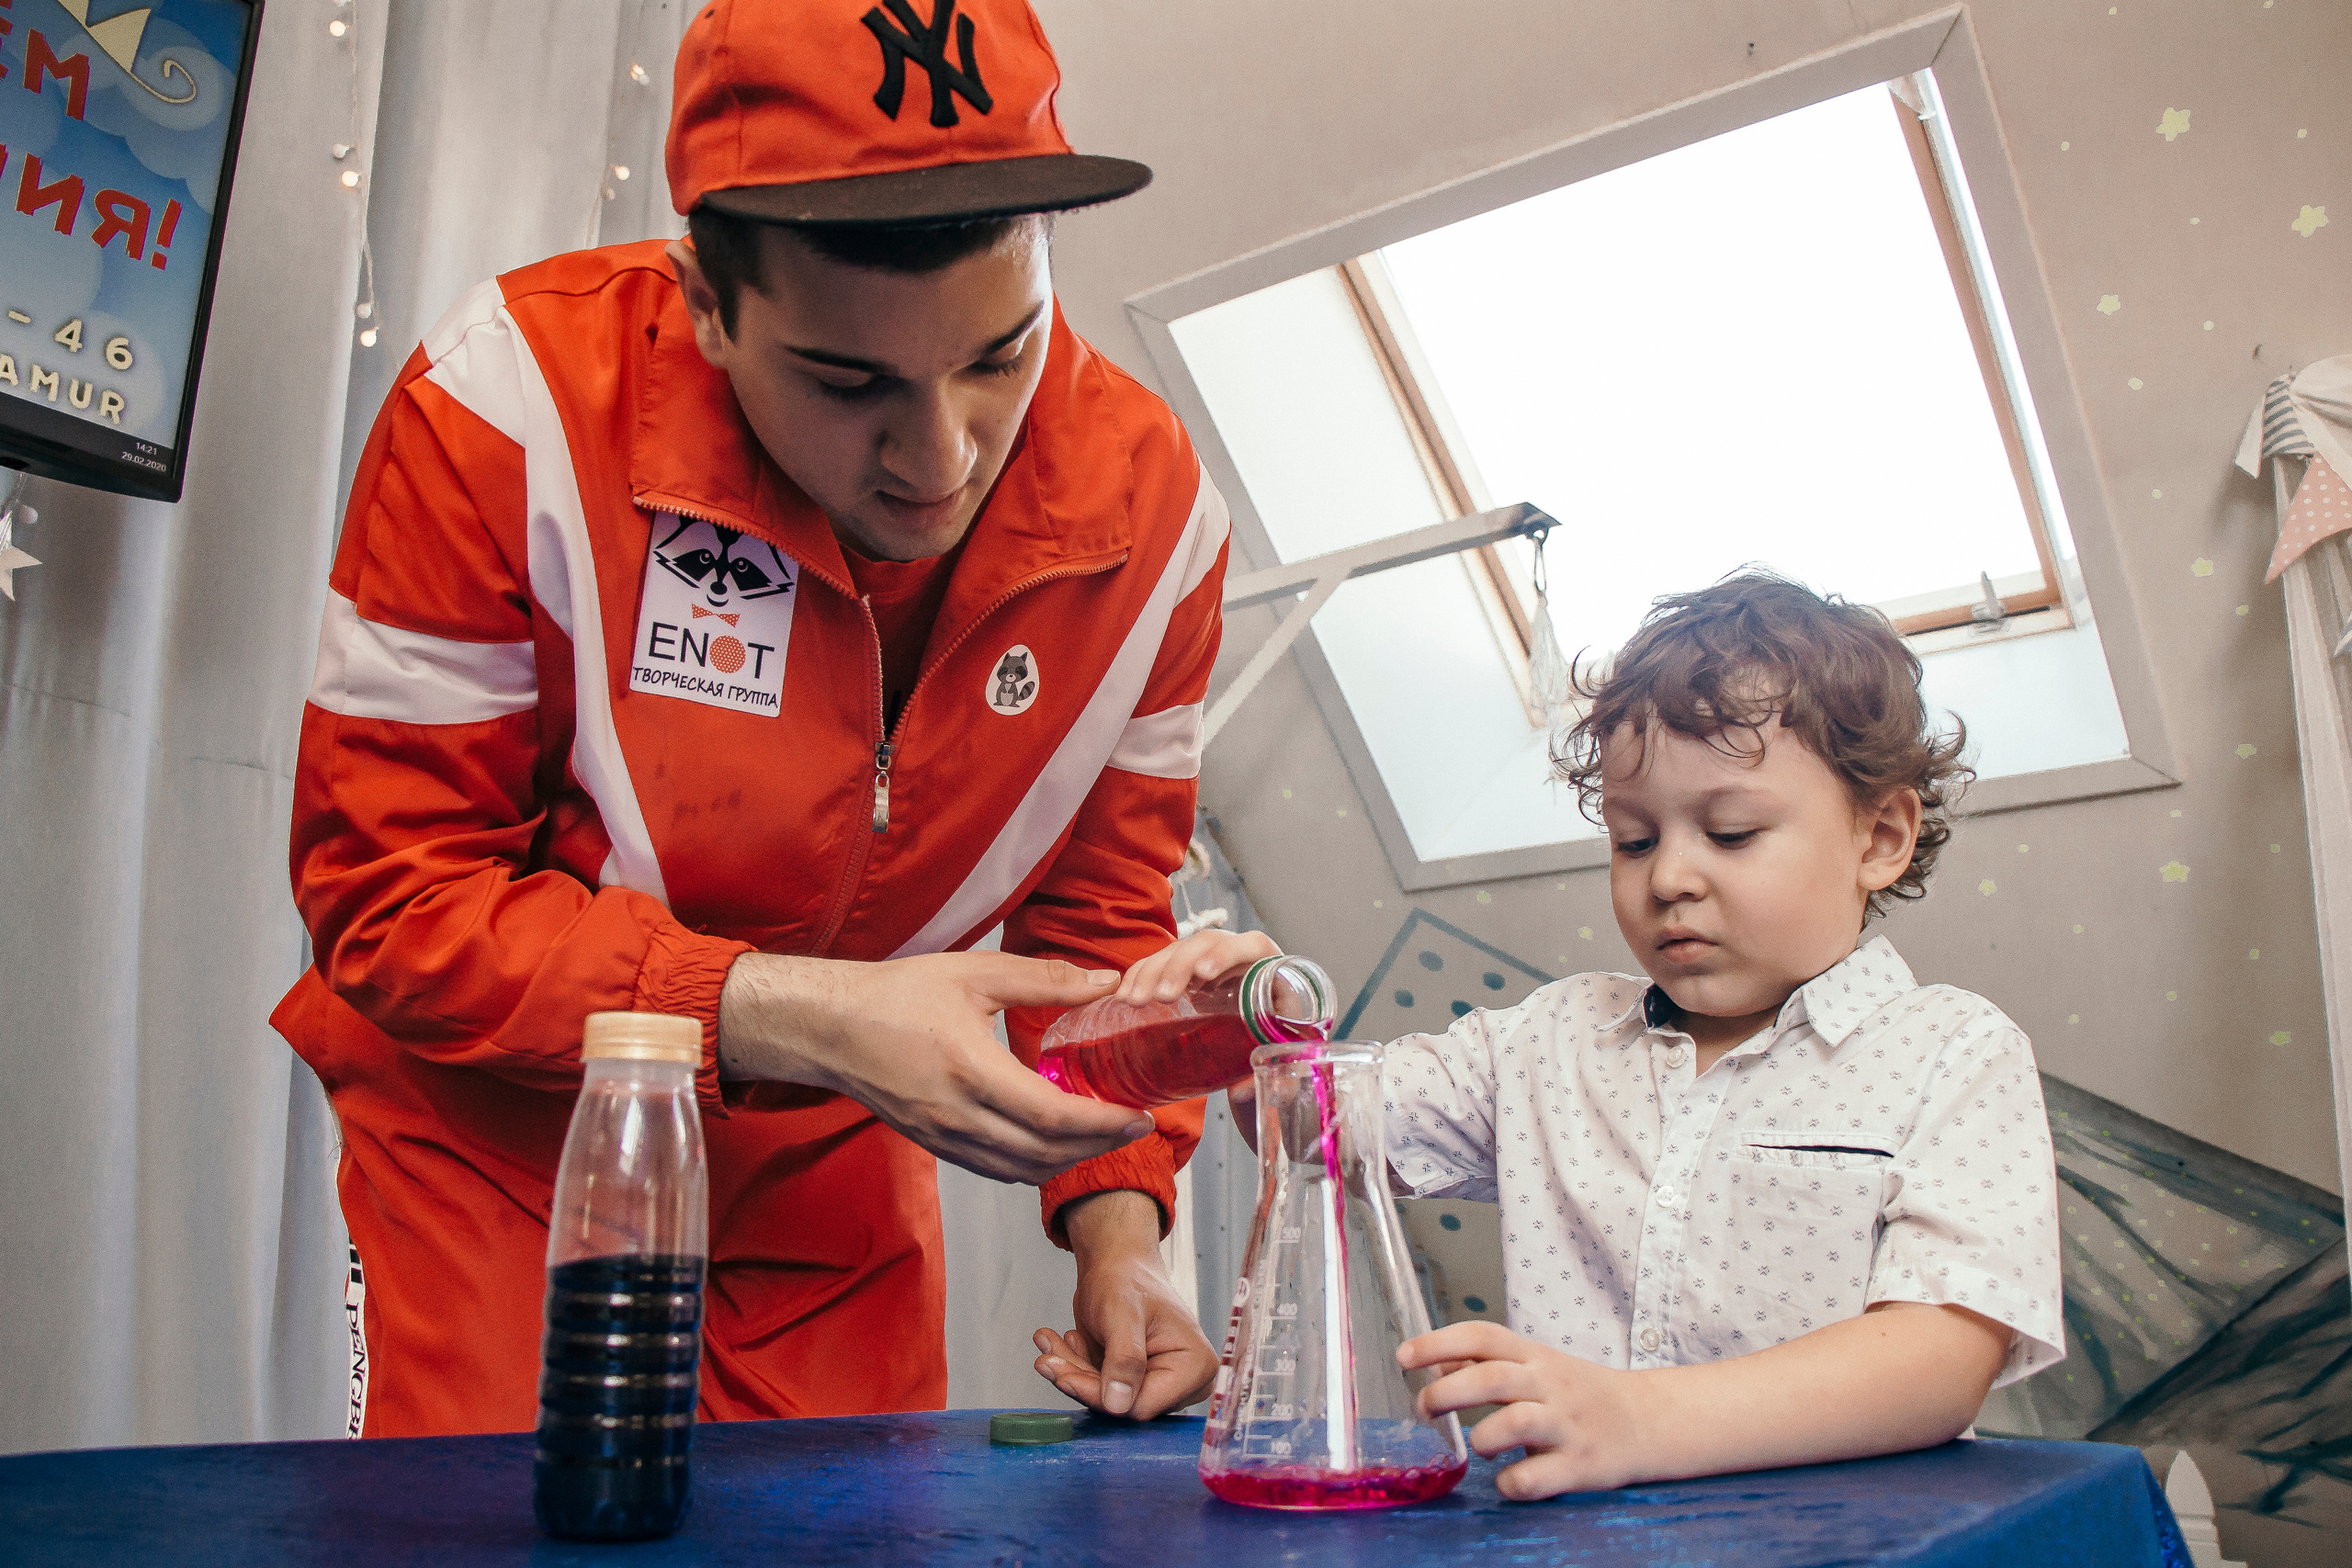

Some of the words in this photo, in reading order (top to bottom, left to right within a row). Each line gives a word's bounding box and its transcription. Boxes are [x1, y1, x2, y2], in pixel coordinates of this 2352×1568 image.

[860, 0, 994, 129] NY
[0, 143, 182, 270] ИЯ!
[121, 451, 166, 472] 29.02.2020
[136, 442, 157, 455] 14:21
[649, 621, 775, 679] ENOT
[632, 666, 725, 697] ТВОРЧЕСКАЯ
[728, 685, 778, 708] ГРУППА
